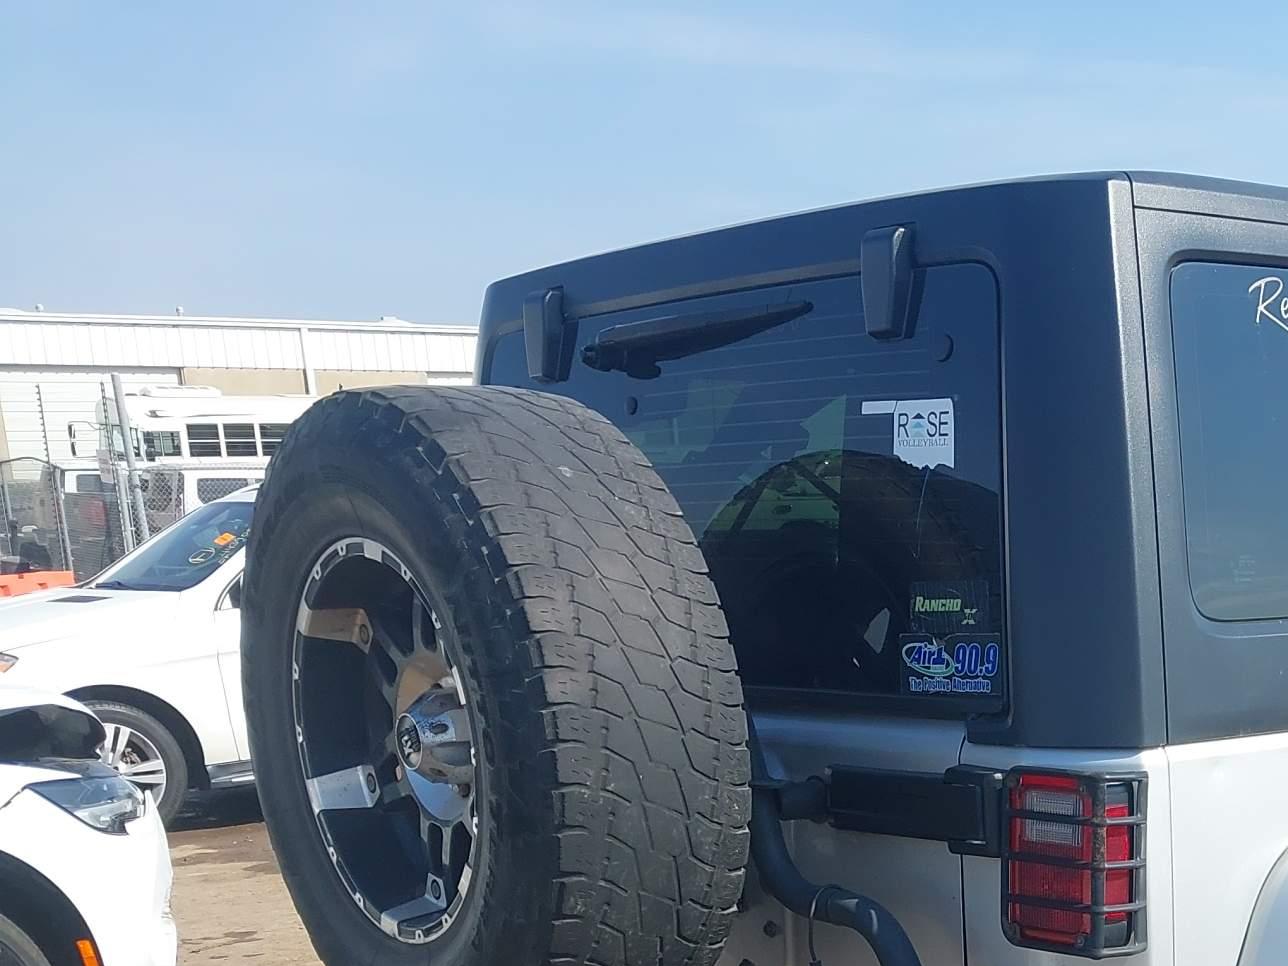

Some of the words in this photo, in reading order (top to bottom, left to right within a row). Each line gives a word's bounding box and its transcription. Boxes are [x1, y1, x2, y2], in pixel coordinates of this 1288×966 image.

[898, 437, 949, 448] VOLLEYBALL
[915, 596, 962, 612] RANCHO
[954, 643, 999, 677] 90.9
[909, 677, 922, 692] The
